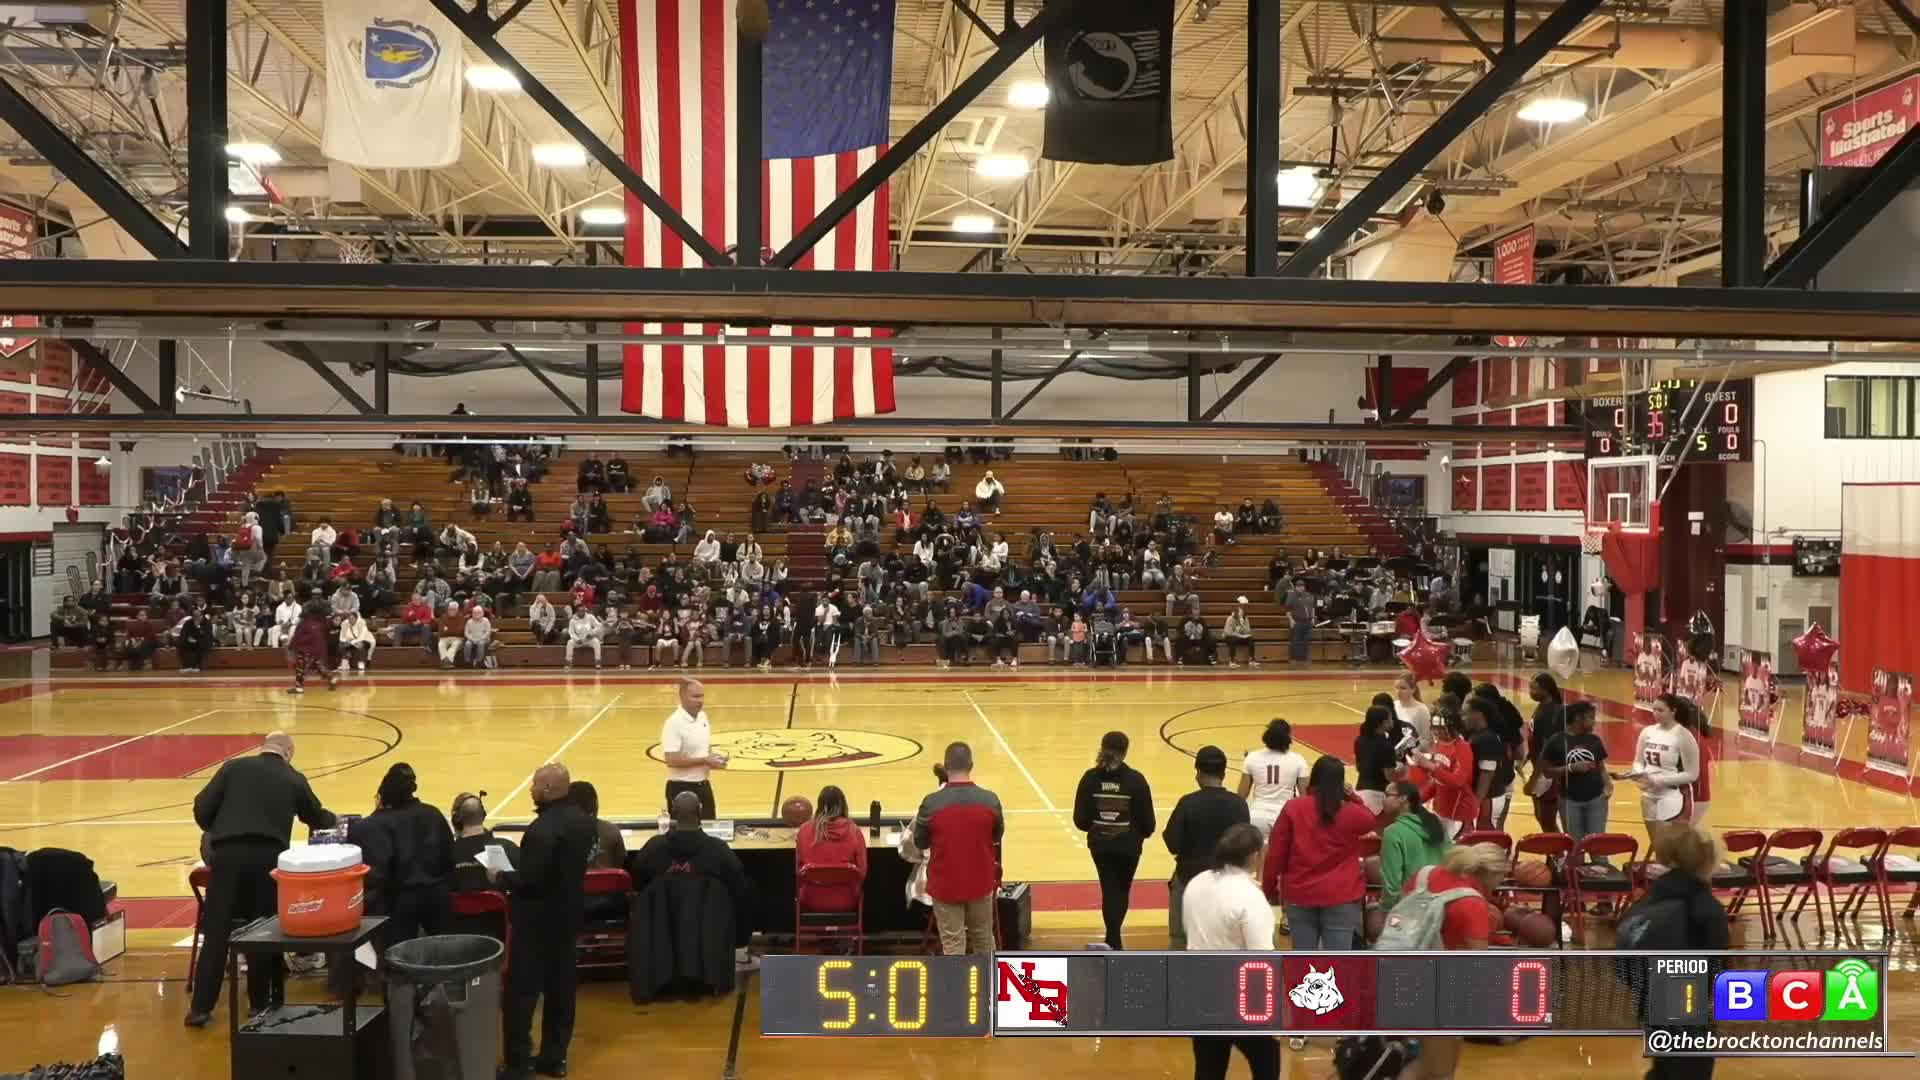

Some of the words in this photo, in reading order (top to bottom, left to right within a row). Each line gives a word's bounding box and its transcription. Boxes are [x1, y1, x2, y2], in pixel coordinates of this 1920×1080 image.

[1842, 109, 1893, 139] Sports
[1830, 116, 1906, 158] Illustrated
[1704, 391, 1736, 402] GUEST
[1724, 403, 1738, 424] 0
[1600, 438, 1610, 453] 0
[1696, 434, 1708, 451] 5
[1727, 433, 1737, 450] 0
[1266, 764, 1280, 785] 11
